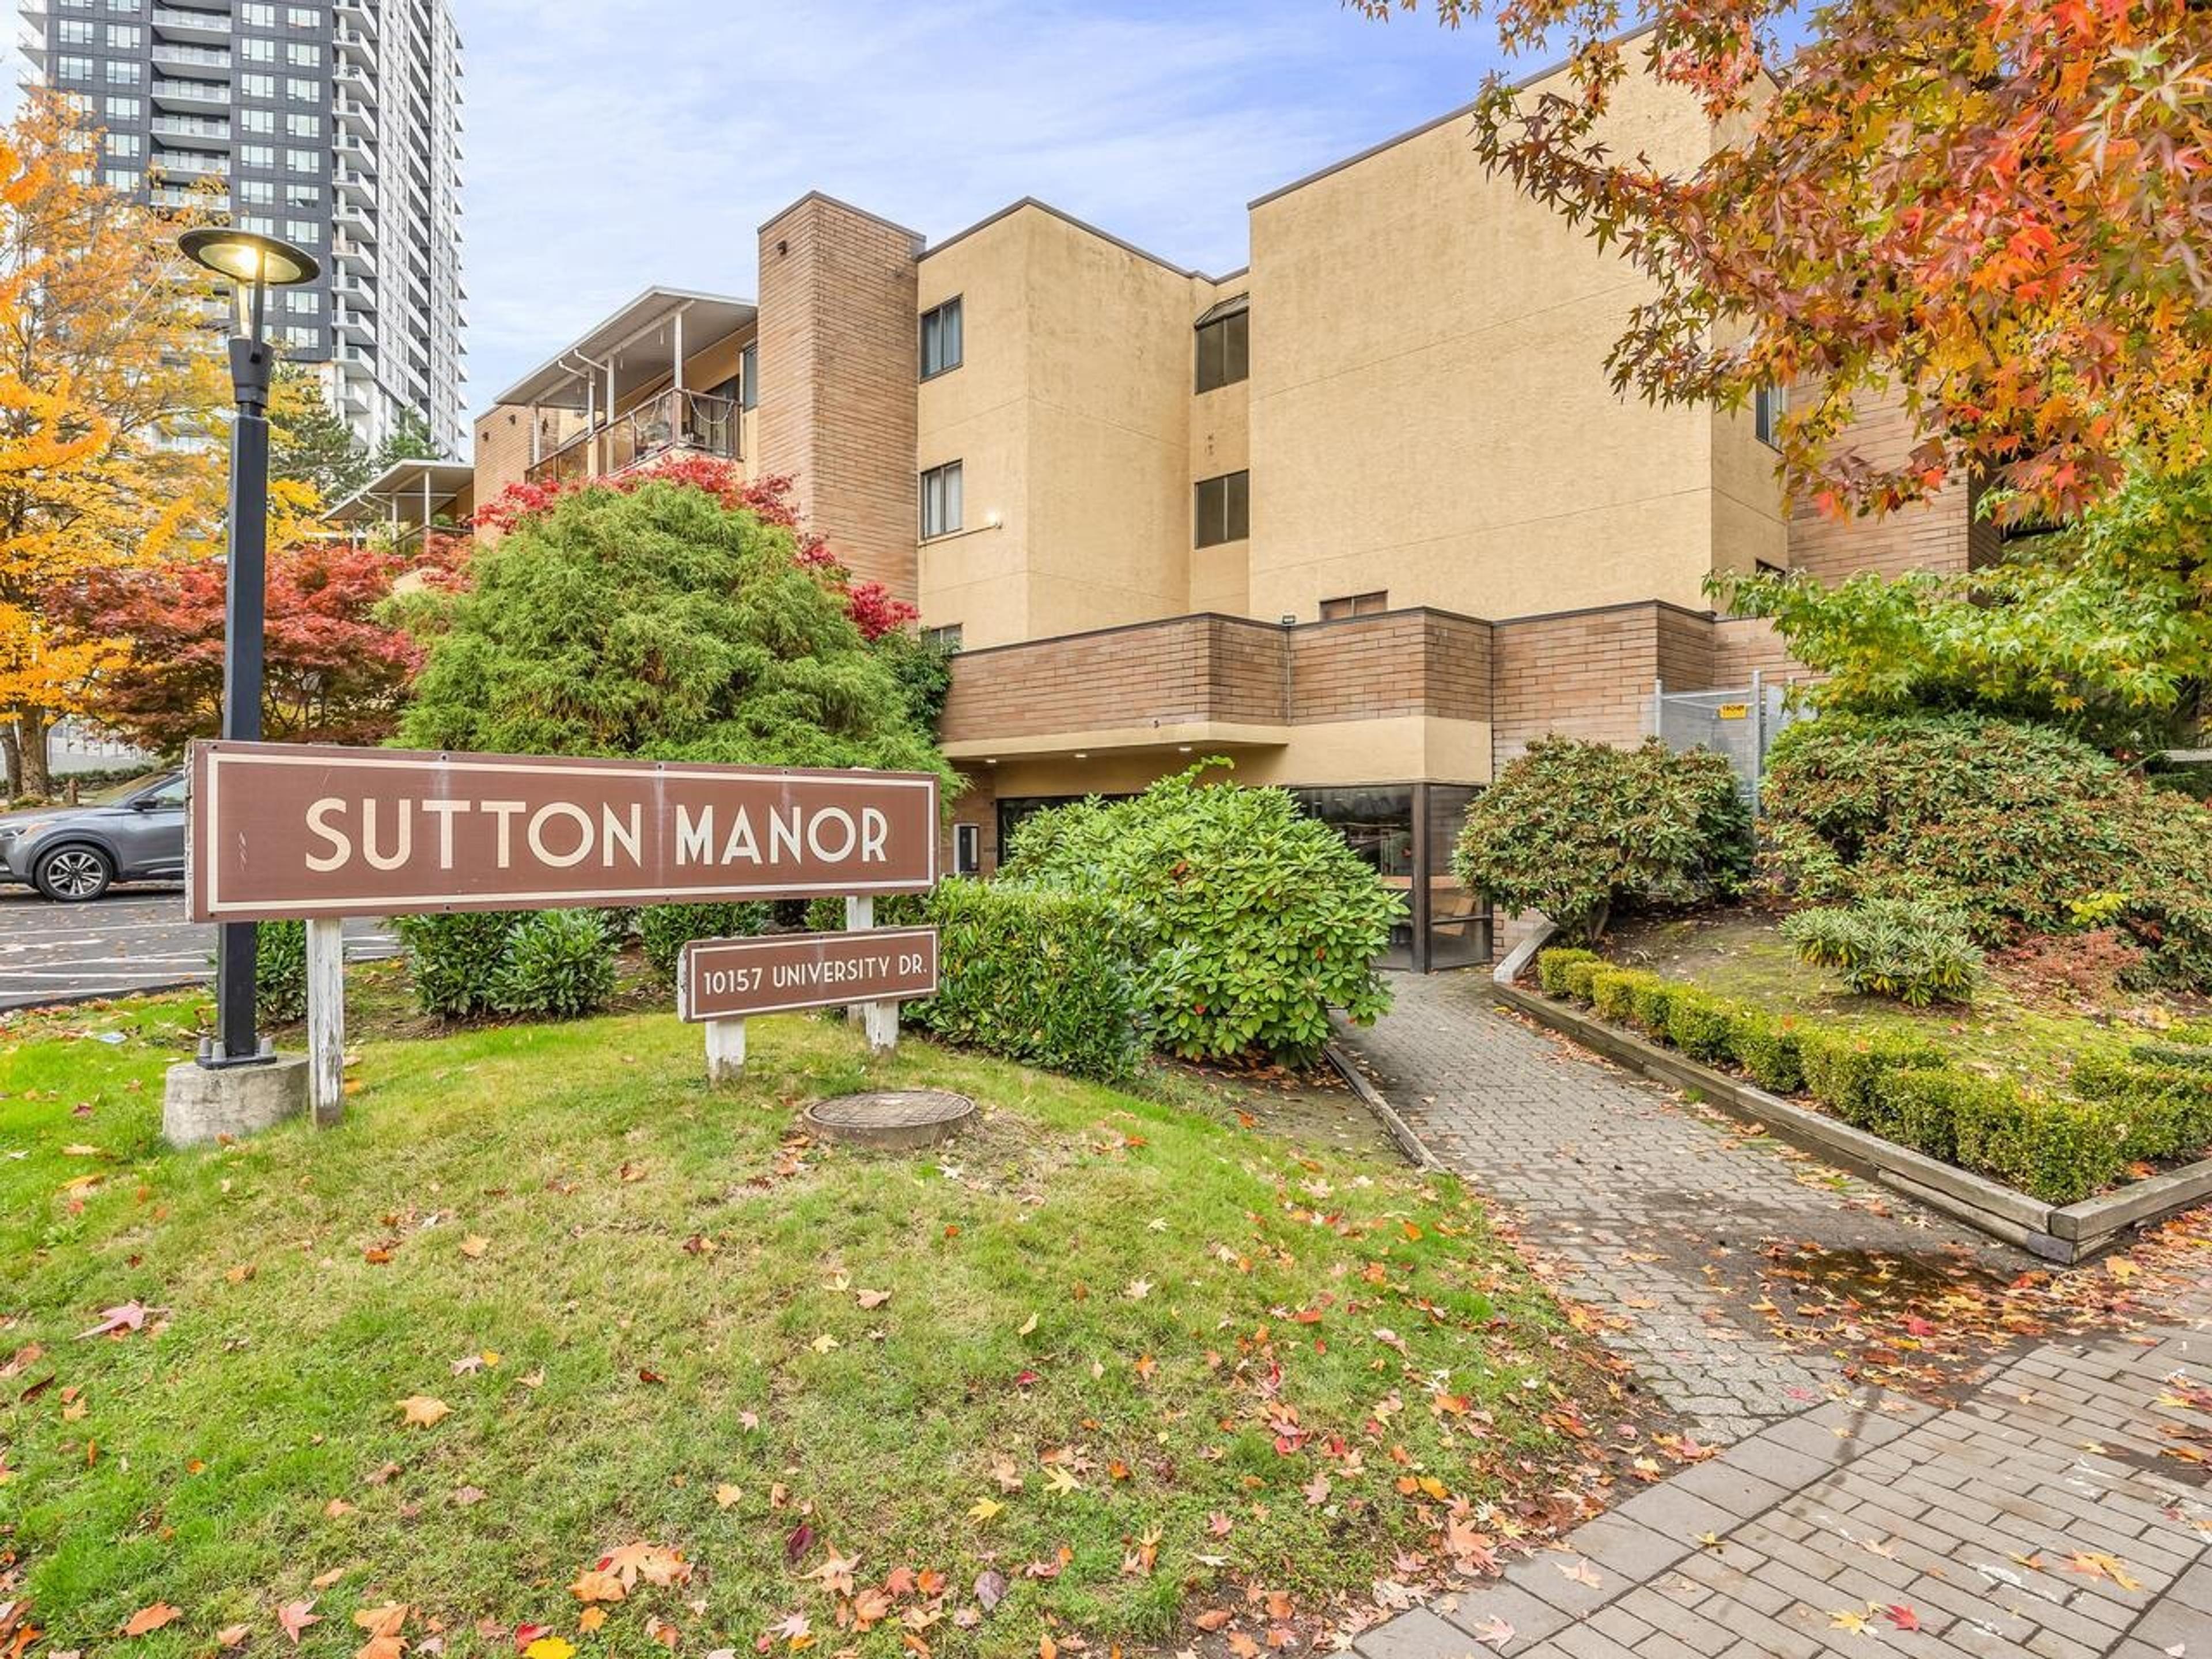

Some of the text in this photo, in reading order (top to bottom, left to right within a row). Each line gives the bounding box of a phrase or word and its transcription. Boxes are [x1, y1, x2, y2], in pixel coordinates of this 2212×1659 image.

[305, 797, 888, 872] SUTTON MANOR
[703, 953, 927, 995] 10157 UNIVERSITY DR.
